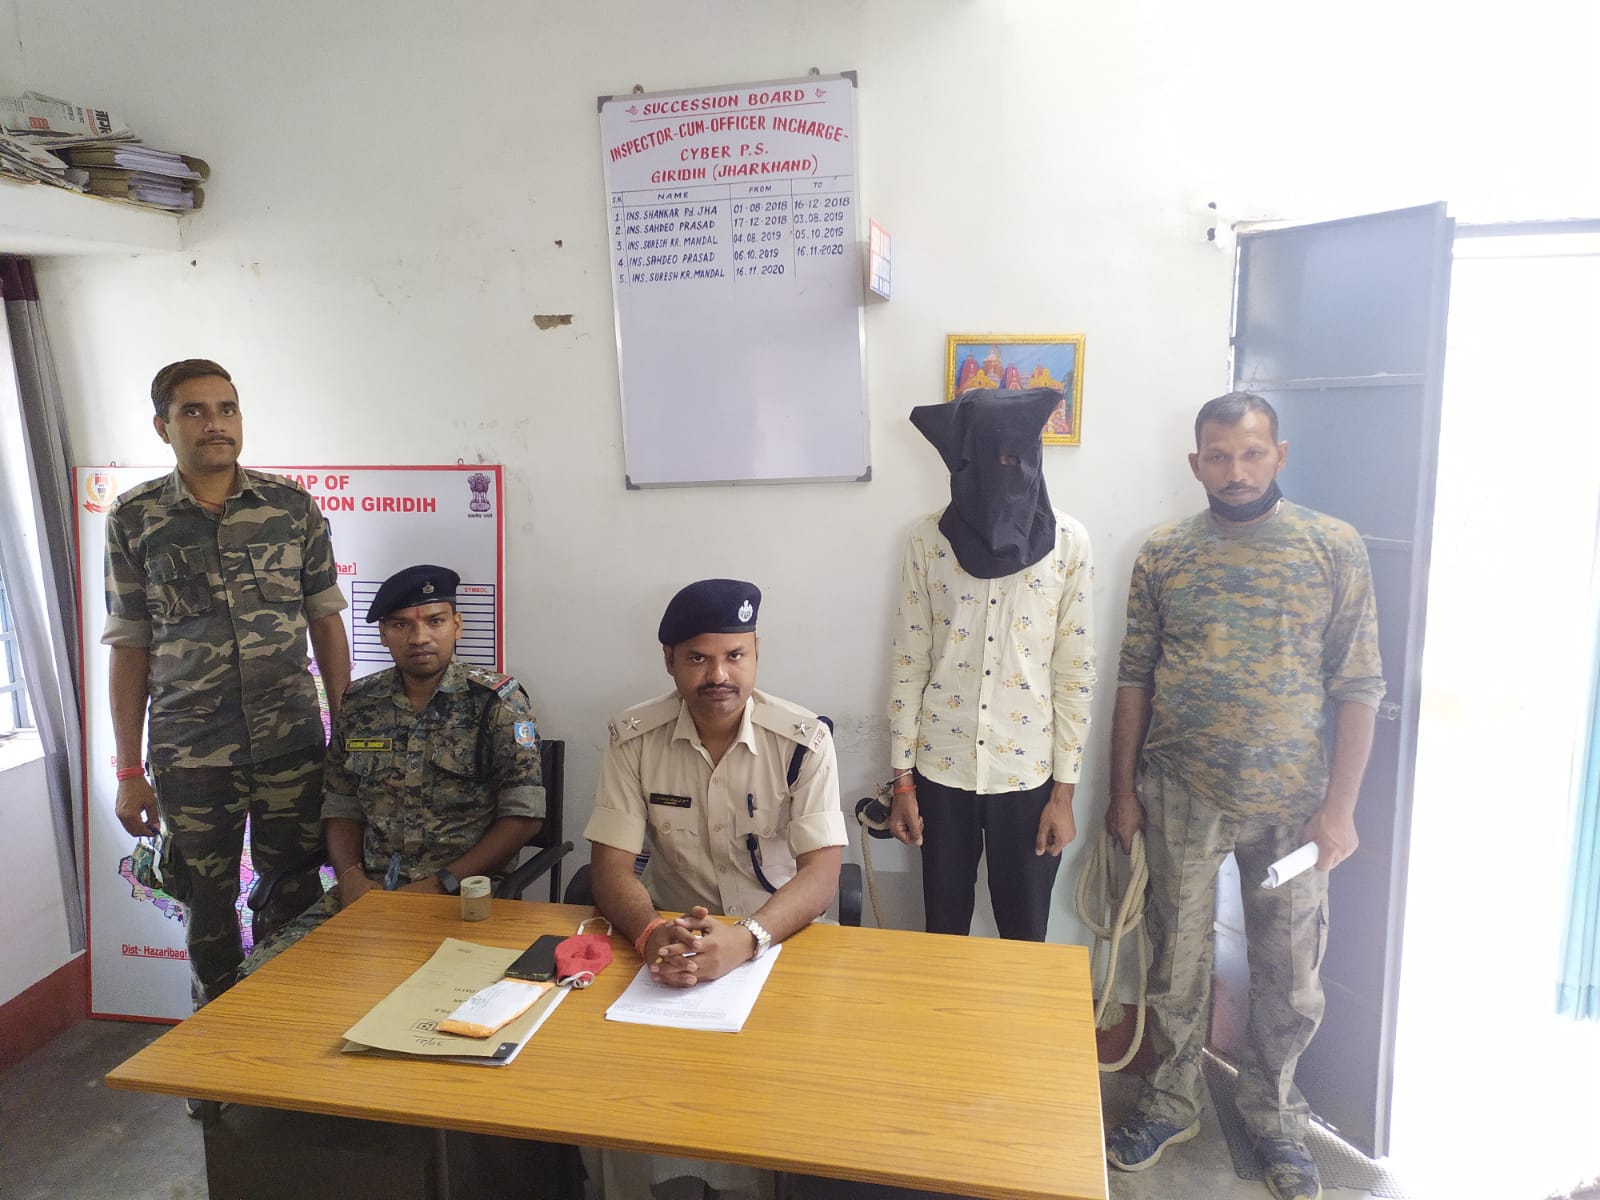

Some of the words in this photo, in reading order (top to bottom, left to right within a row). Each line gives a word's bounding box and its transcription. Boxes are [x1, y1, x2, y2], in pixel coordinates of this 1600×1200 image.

[642, 95, 739, 116] SUCCESSION
[748, 89, 805, 106] BOARD
[680, 146, 731, 161] CYBER
[740, 142, 769, 157] P.S.
[651, 167, 706, 184] GIRIDIH
[712, 154, 819, 181] (JHARKHAND)
[748, 185, 772, 193] FROM
[813, 181, 823, 189] TO
[657, 191, 689, 200] NAME
[679, 220, 715, 231] PRASAD
[683, 235, 718, 247] MANDAL
[682, 251, 715, 263] PRASAD
[324, 474, 350, 490] OF
[361, 496, 437, 513] GIRIDIH
[121, 943, 142, 955] Dist-
